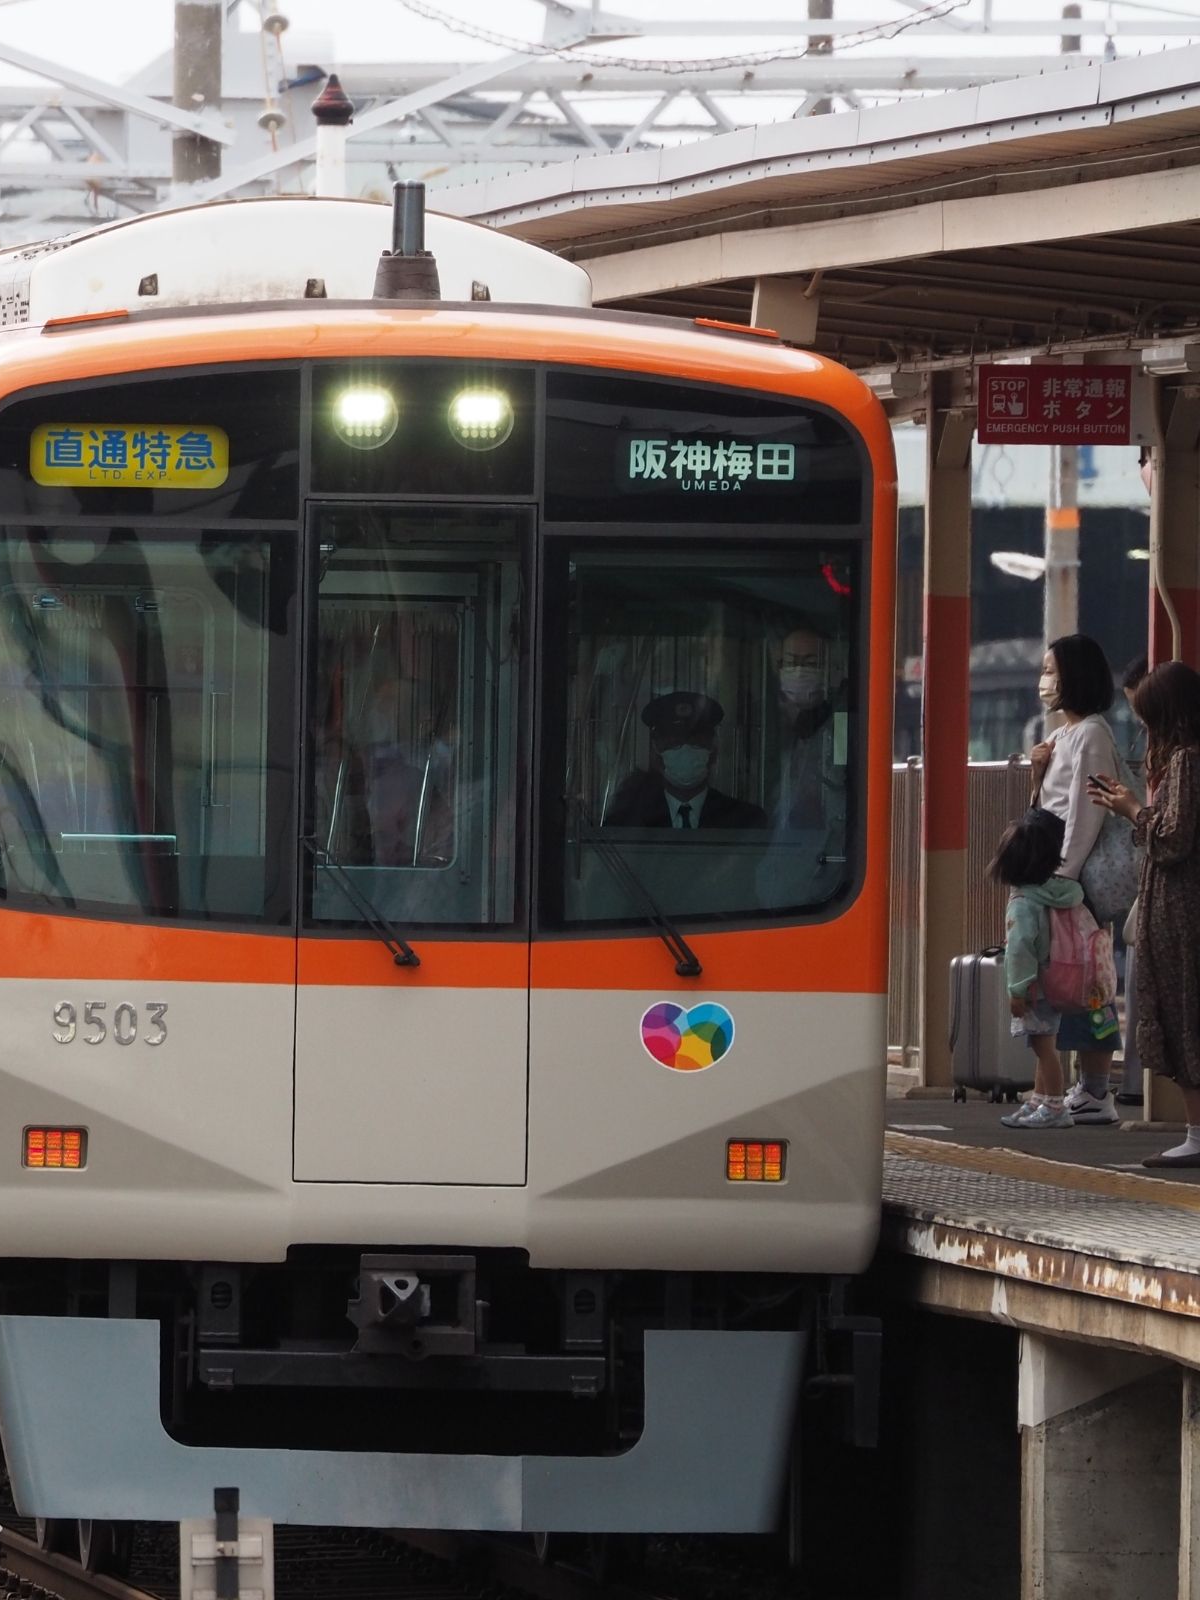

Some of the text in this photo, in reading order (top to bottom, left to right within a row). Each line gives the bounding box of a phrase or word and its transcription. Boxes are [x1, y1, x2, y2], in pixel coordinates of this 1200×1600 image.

[991, 380, 1026, 391] STOP
[1042, 378, 1126, 398] 非常通報
[1042, 400, 1124, 419] ボタン
[986, 423, 1126, 434] EMERGENCY PUSH BUTTON
[45, 428, 216, 470] 直通特急
[629, 439, 795, 481] 阪神梅田
[681, 480, 742, 491] UMEDA
[52, 1000, 168, 1047] 9503
